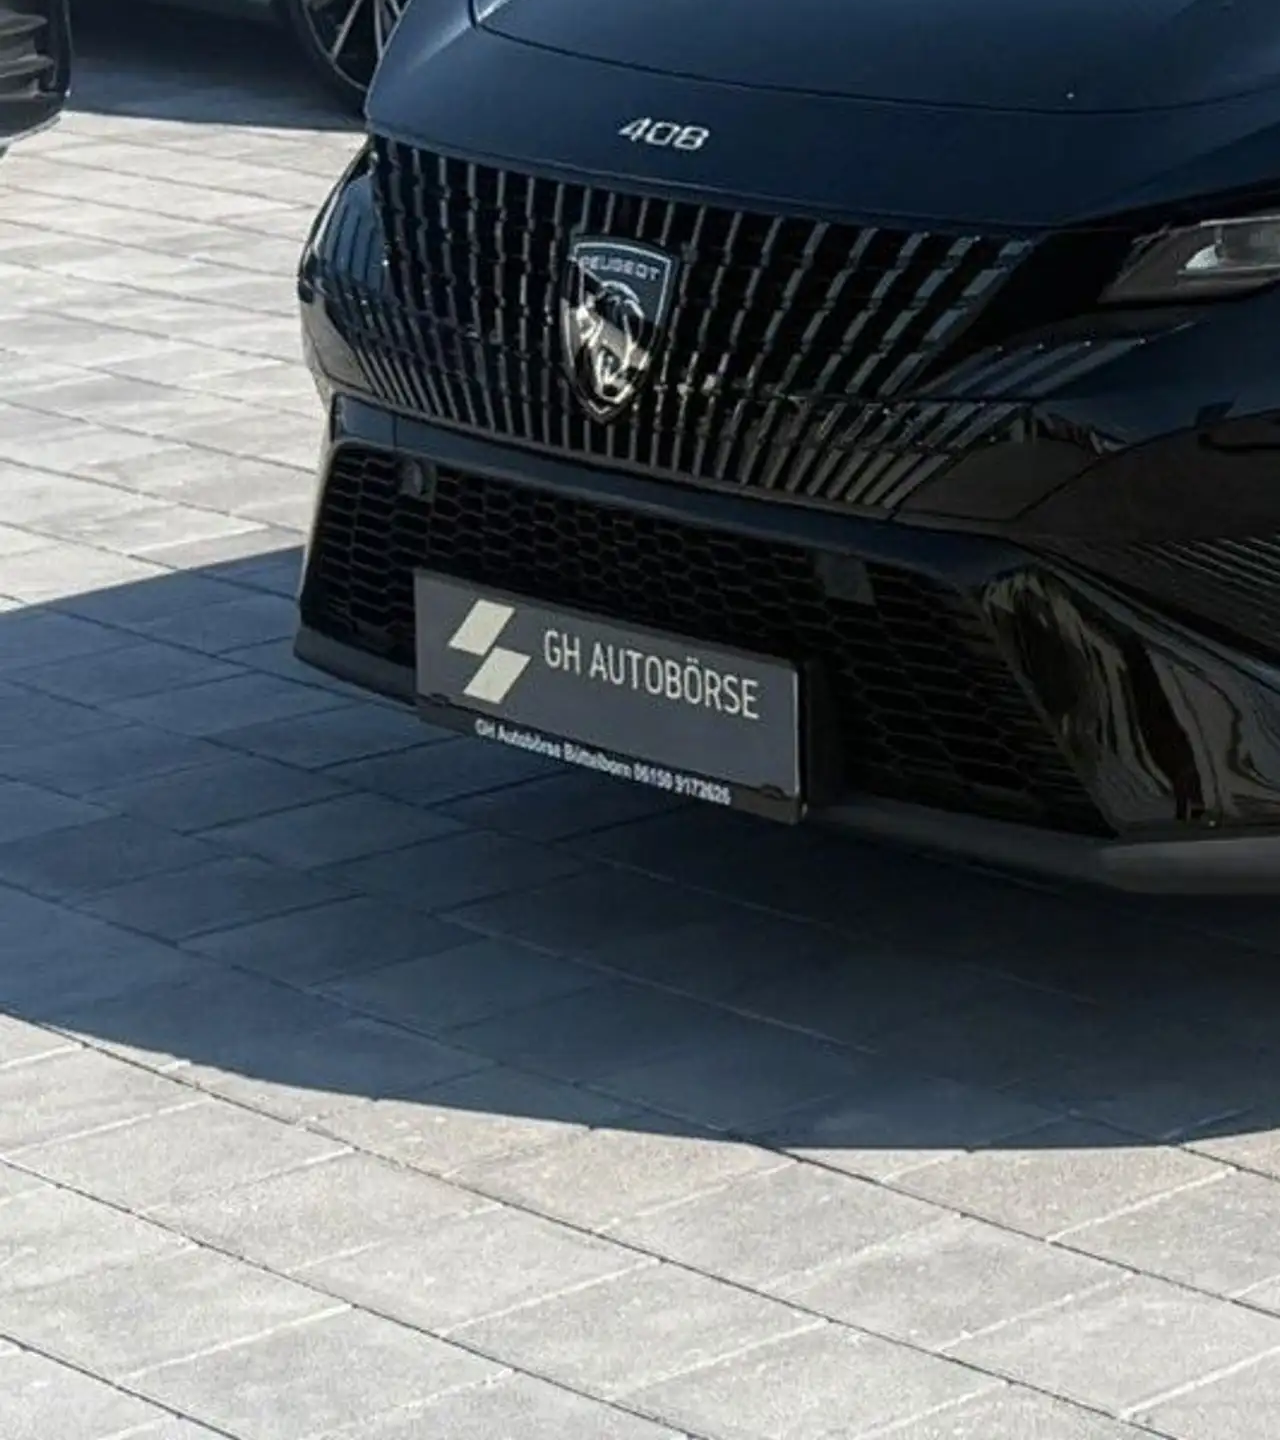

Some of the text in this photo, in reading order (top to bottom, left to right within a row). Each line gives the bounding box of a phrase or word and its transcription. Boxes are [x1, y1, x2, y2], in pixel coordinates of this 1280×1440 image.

[619, 117, 710, 151] 408
[579, 256, 661, 281] PEUGEOT
[544, 629, 760, 720] GH AUTOBÖRSE
[474, 717, 496, 738] GH
